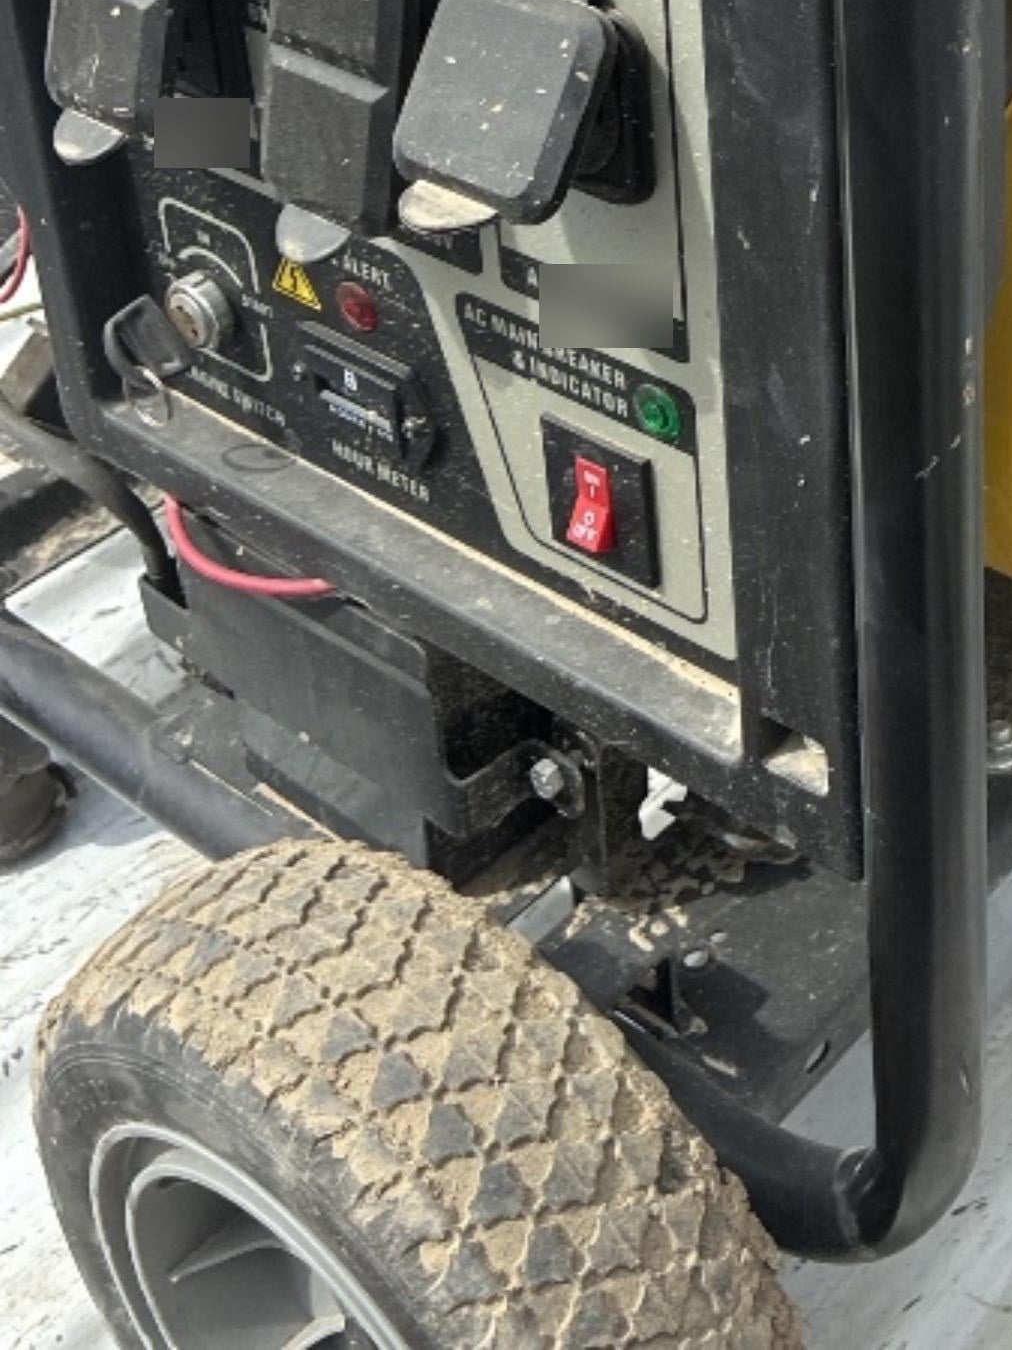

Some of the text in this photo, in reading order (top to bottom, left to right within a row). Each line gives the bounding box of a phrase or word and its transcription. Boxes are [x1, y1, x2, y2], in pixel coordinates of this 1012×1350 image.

[463, 301, 627, 391] AC MAIN REAKER
[529, 355, 629, 418] INDICATOR
[376, 461, 430, 503] METER
